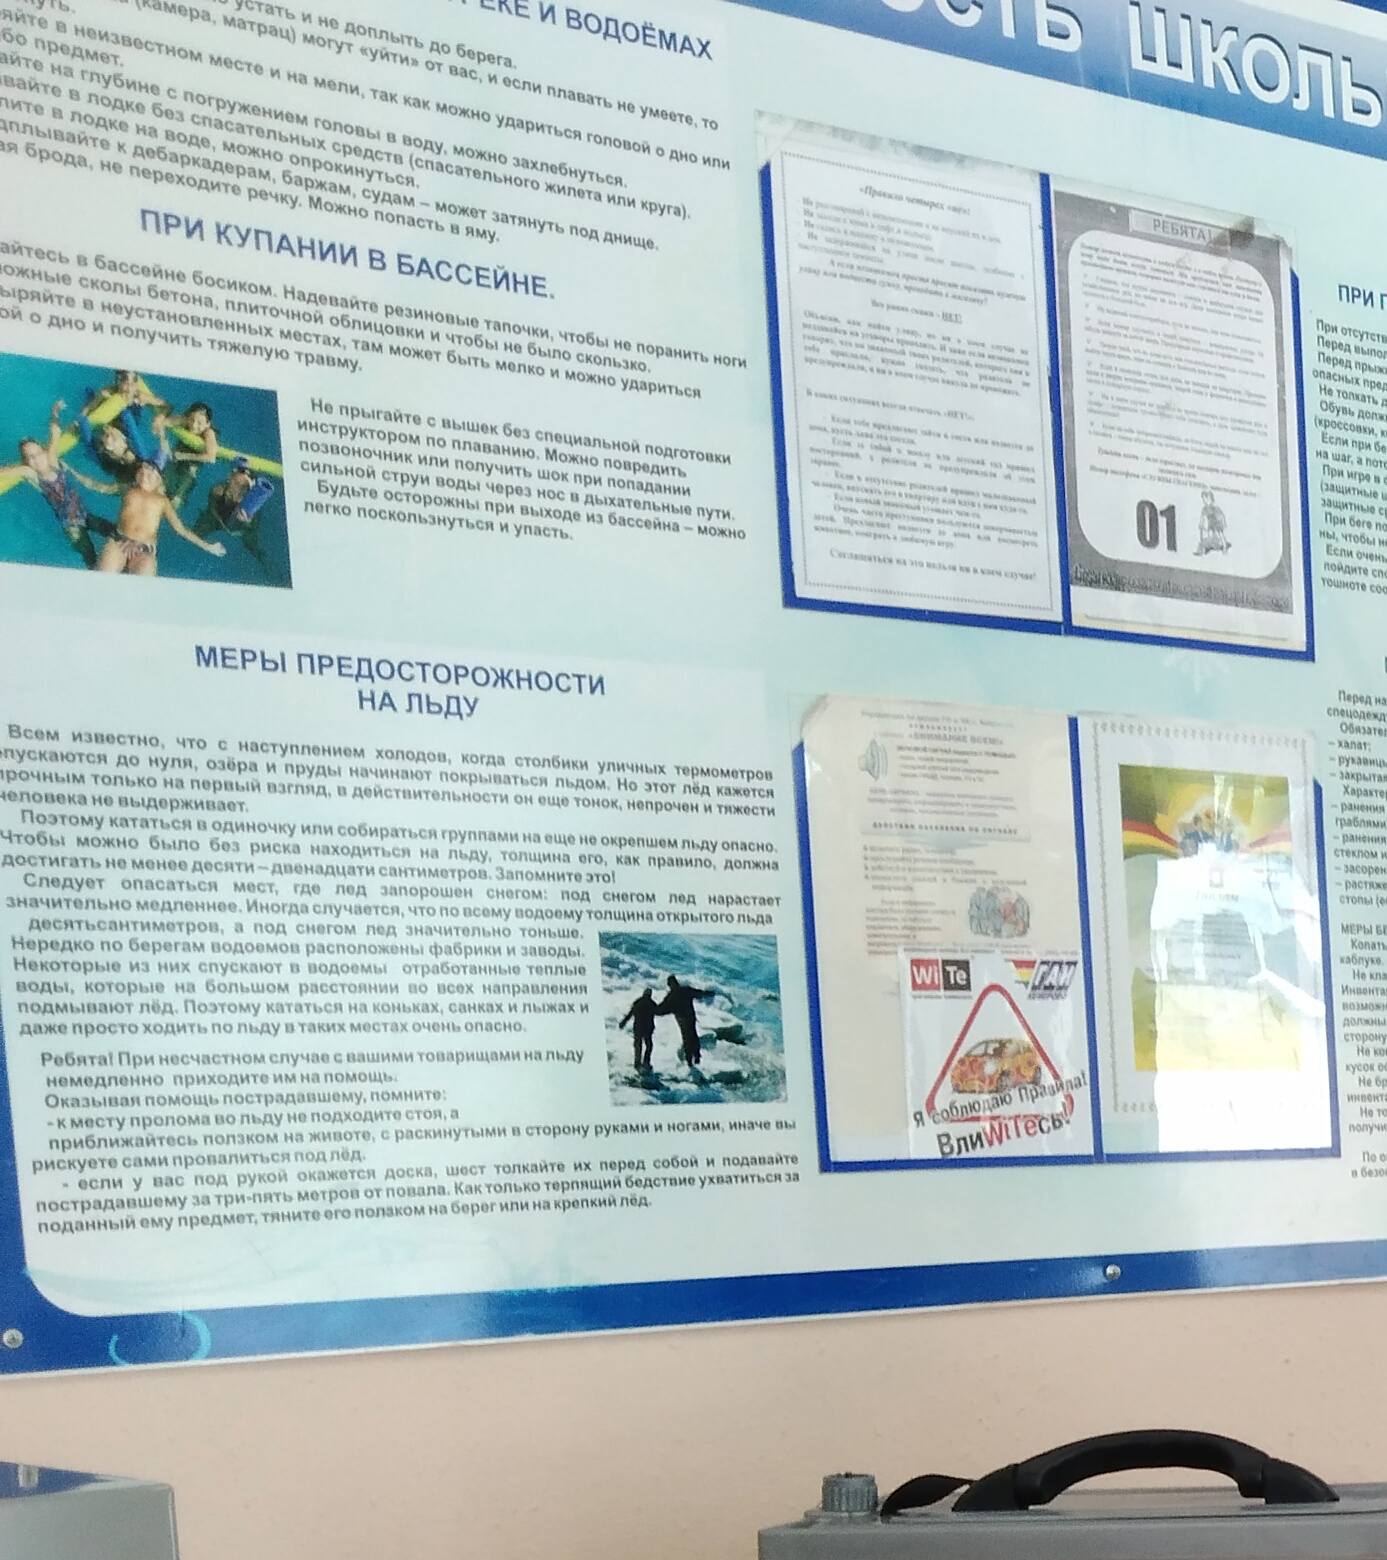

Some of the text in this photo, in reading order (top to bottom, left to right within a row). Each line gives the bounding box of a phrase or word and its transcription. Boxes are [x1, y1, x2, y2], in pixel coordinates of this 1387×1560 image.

[540, 4, 557, 24] И
[566, 9, 714, 60] ВОДОЁМАХ
[139, 208, 555, 298] ПРИ КУПАНИИ В БАССЕЙНЕ.
[1152, 218, 1214, 243] РЕБЯТА!
[1337, 283, 1375, 308] ПРИ
[1318, 382, 1334, 397] Не
[1335, 388, 1379, 406] толкать
[296, 420, 687, 478] инструктором по плаванию. Можно повредить
[310, 397, 731, 464] Не прыгайте с вышек без специальной подготовки
[297, 440, 691, 497] позвоночник или получить шок при попадании
[299, 460, 735, 521] сильной струи воды через нос в дыхательные пути.
[1321, 463, 1345, 479] При
[1345, 469, 1371, 484] игре
[1373, 473, 1381, 485] в
[303, 500, 573, 540] легко поскользнуться и упасть.
[316, 478, 747, 540] Будьте осторожны при выходе из бассейна можно
[1135, 500, 1178, 552] 01
[194, 645, 605, 695] МЕРЫ ПРЕДОСТОРОЖНОСТИ
[357, 688, 479, 720] НА ЛЬДУ
[1340, 922, 1373, 935] МЕРЫ
[39, 1049, 585, 1069] Ребята! При несчастном случае с вашими товарищами на льду
[45, 1071, 398, 1089] немедленно приходите им на помощь.
[912, 1069, 1087, 1128] Я соблюдаю Правила!
[937, 1102, 1071, 1158] ВлиWiTeсь!
